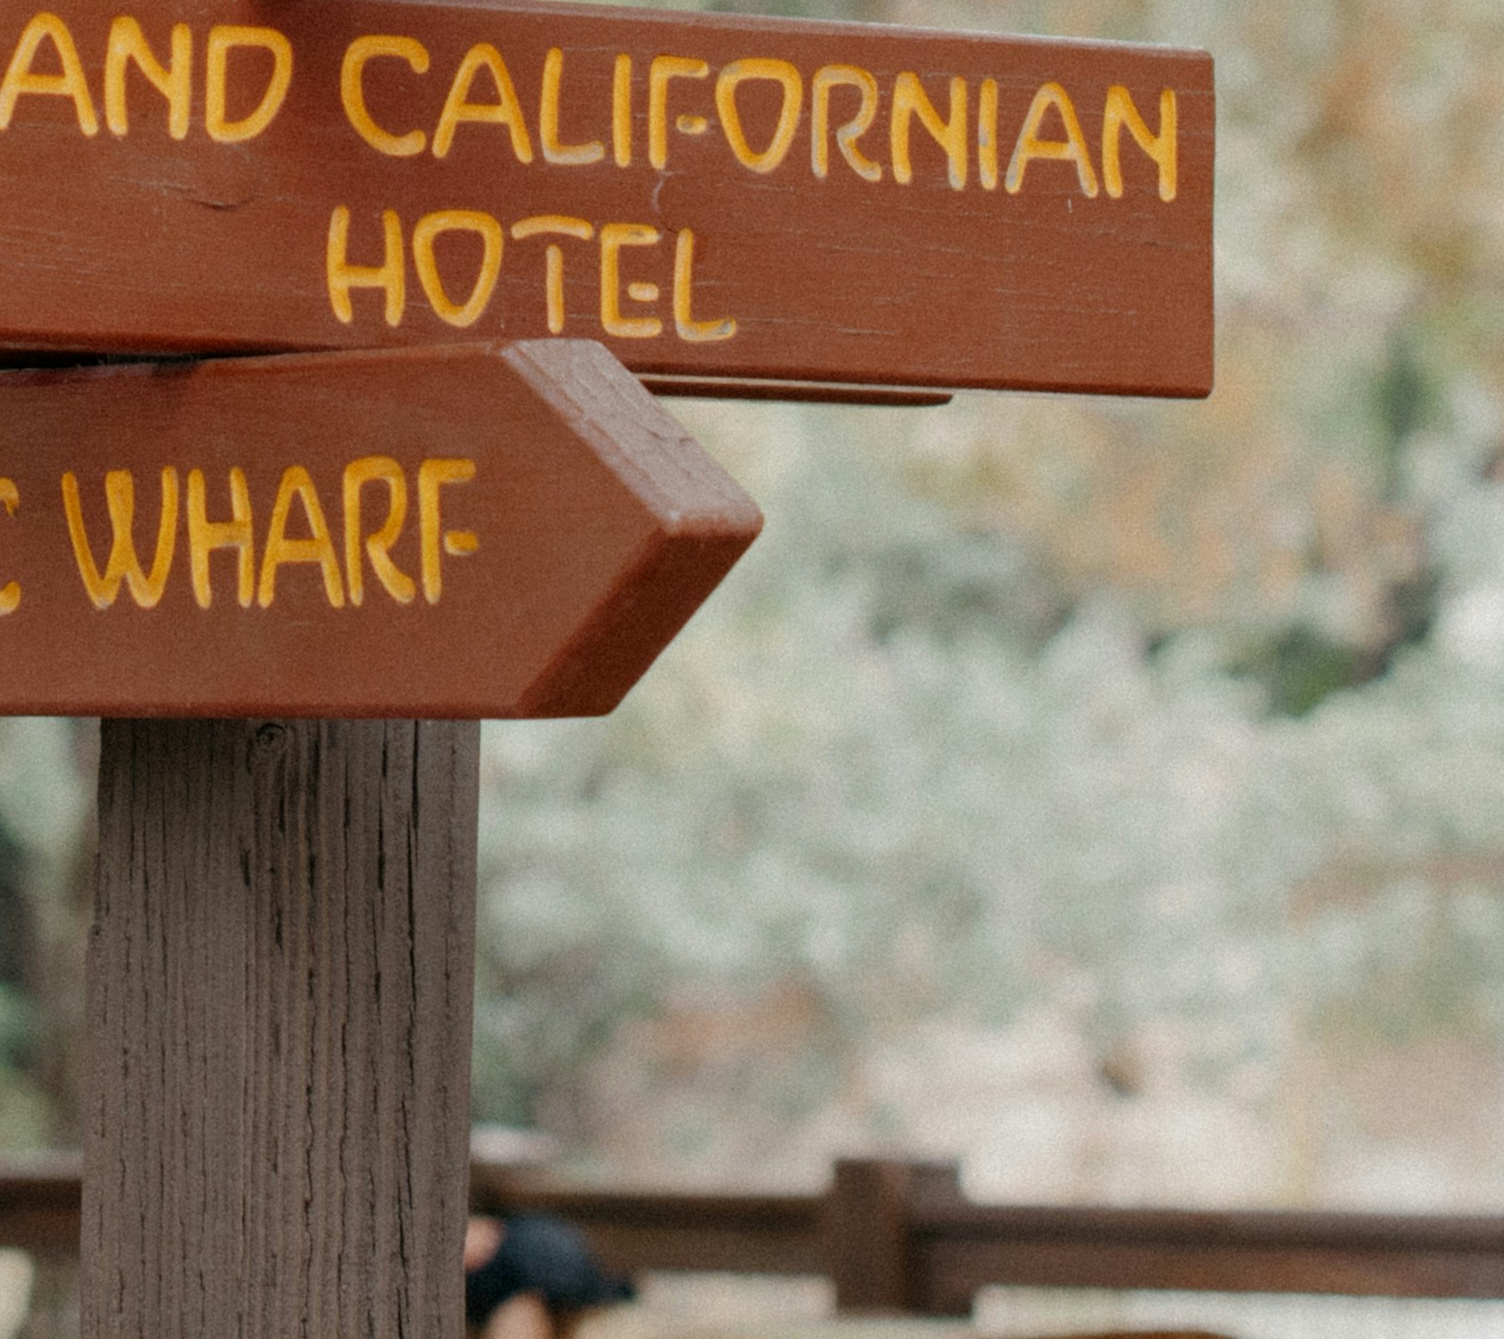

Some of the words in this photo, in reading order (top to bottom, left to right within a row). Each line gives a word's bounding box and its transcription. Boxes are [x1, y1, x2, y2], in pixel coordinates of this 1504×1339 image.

[336, 31, 1181, 206] CALIFORNIAN
[323, 202, 740, 341] HOTEL
[58, 451, 482, 612] WHARF
